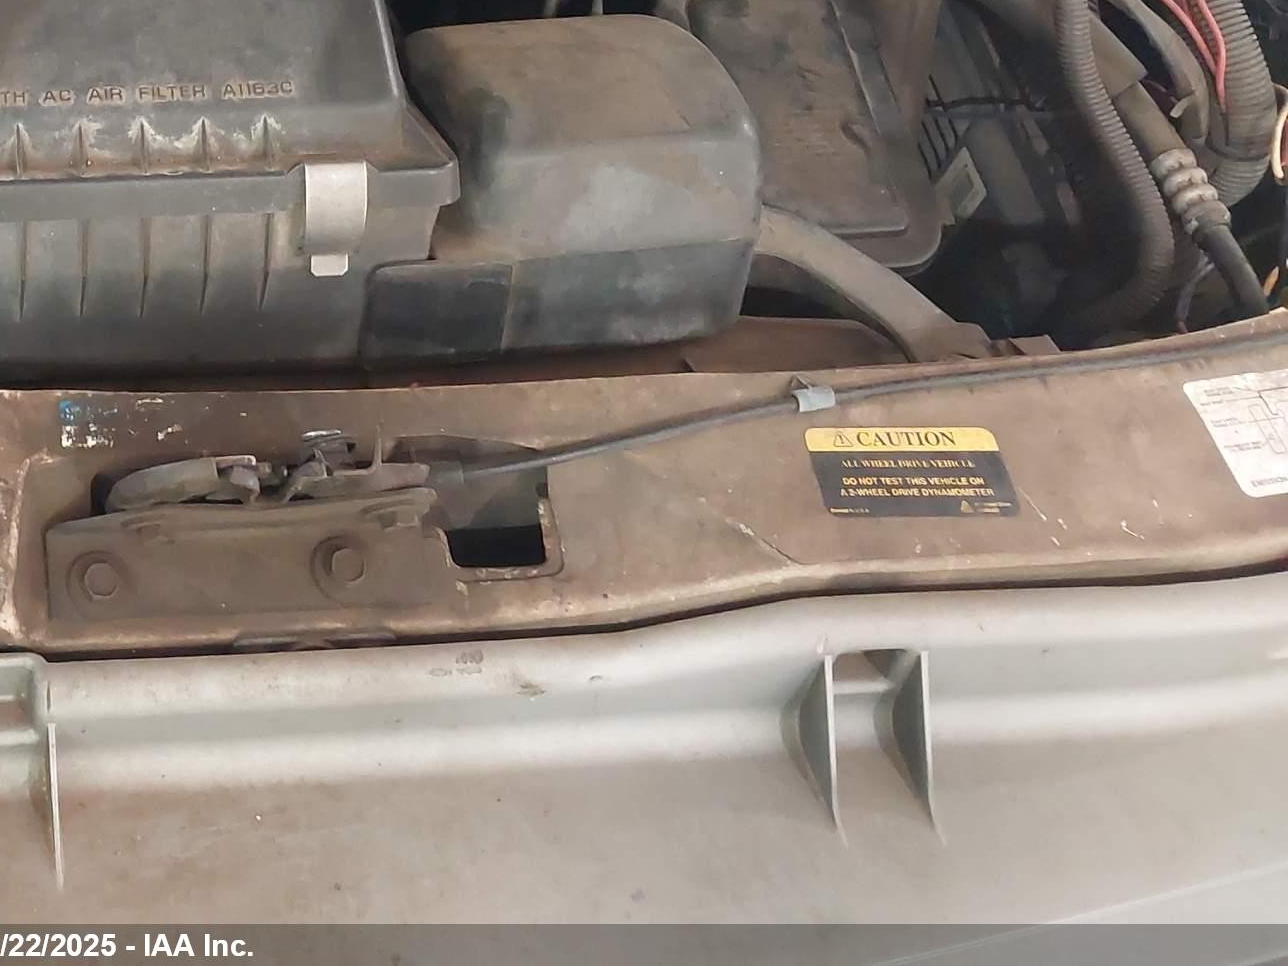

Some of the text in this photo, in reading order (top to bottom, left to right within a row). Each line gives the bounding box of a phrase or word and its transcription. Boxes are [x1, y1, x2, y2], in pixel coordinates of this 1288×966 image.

[42, 88, 73, 104] AC
[88, 87, 124, 102] AIR
[138, 84, 207, 100] FILTER
[856, 431, 956, 447] CAUTION
[842, 459, 976, 469] ALL WHEEL DRIVE VEHICLE
[842, 477, 985, 485] DO NOT TEST THIS VEHICLE ON
[840, 488, 848, 497] A
[892, 488, 920, 497] DRIVE
[922, 488, 995, 497] DYNAMOMETER
